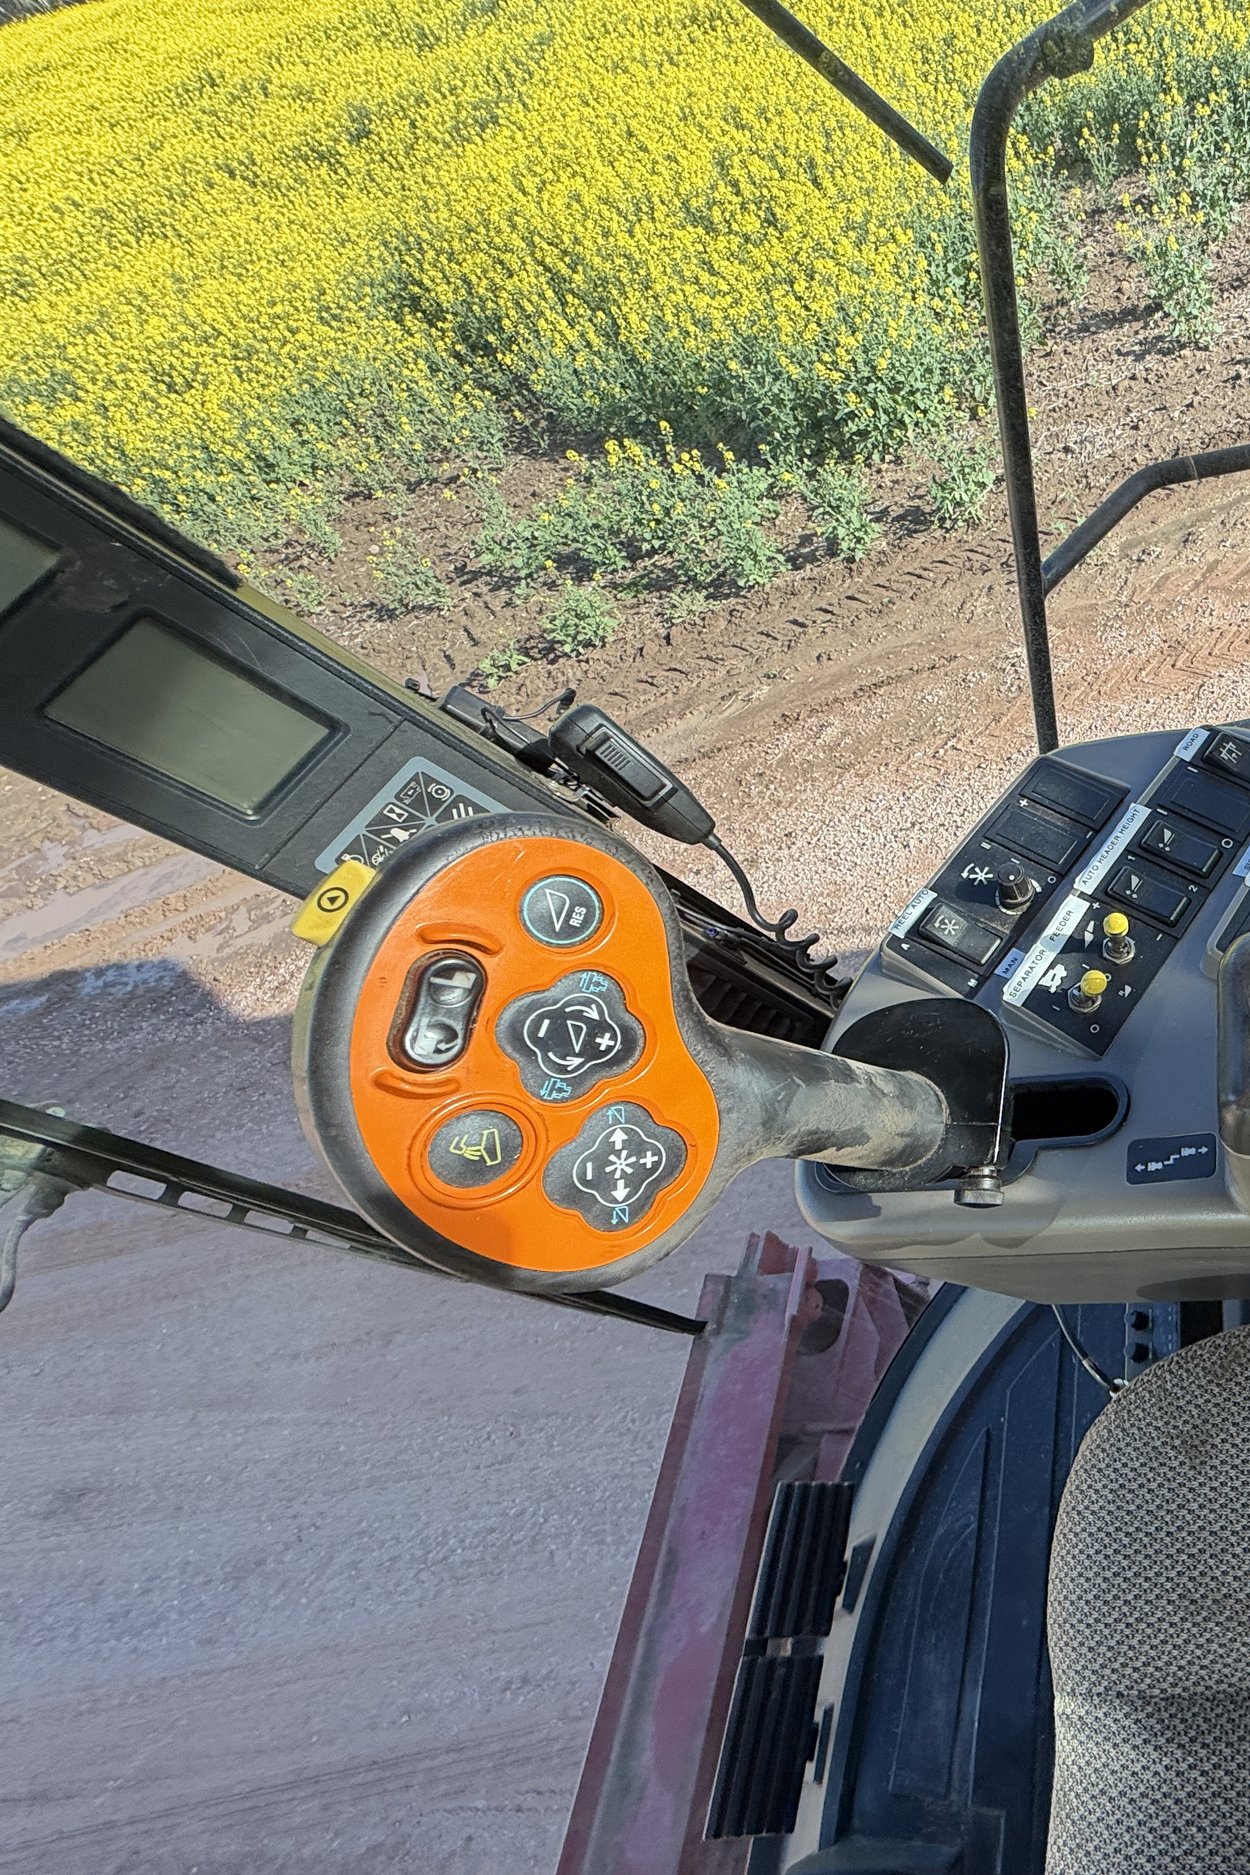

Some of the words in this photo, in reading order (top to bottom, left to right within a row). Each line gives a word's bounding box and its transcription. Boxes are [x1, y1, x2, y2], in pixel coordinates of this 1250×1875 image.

[1183, 733, 1199, 751] ROAD
[1082, 865, 1099, 885] AUTO
[1100, 835, 1120, 864] HEADER
[1120, 809, 1140, 834] HEIGHT
[569, 906, 587, 927] RES
[894, 910, 912, 930] REEL
[912, 889, 928, 910] AUTO
[1049, 910, 1074, 942] FEEDER
[1003, 957, 1018, 975] MAN
[1009, 949, 1046, 998] SEPARATOR
